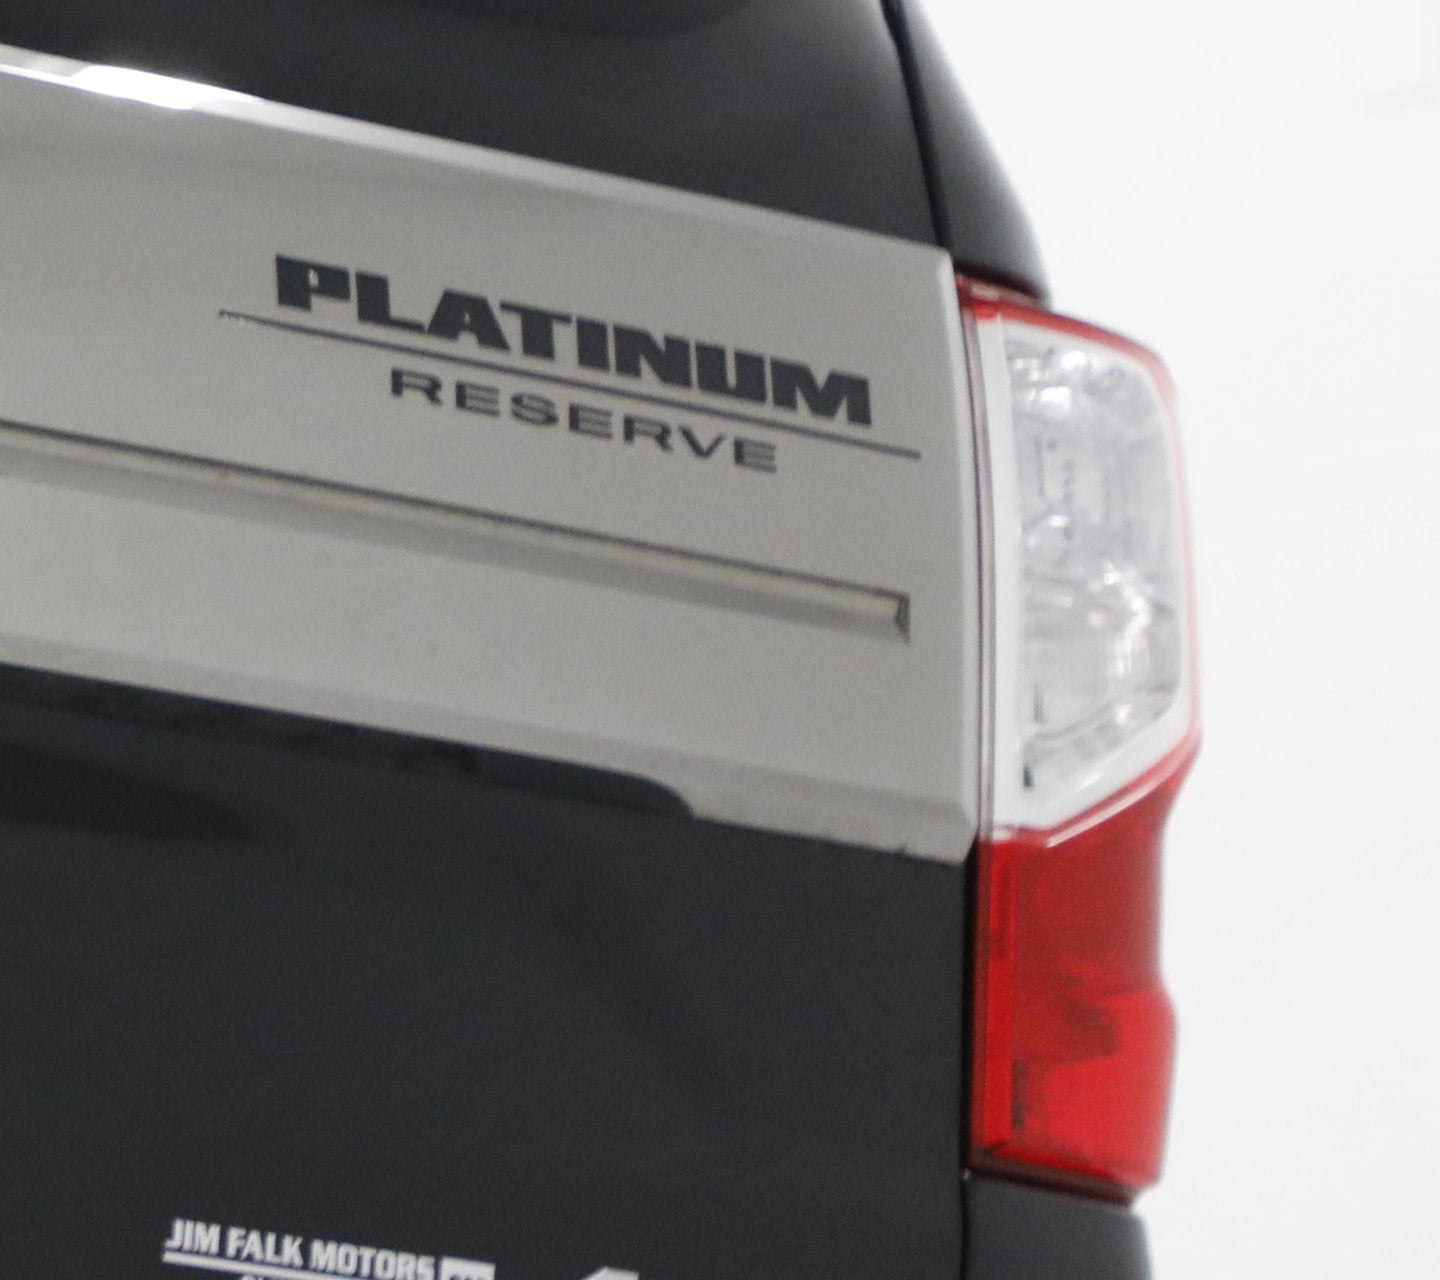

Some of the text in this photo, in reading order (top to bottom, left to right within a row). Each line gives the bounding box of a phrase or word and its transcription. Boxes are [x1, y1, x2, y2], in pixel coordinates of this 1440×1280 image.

[275, 253, 873, 426] PLATINUM
[390, 367, 778, 474] RESERVE
[166, 1218, 221, 1258] JIM
[226, 1226, 304, 1269] FALK
